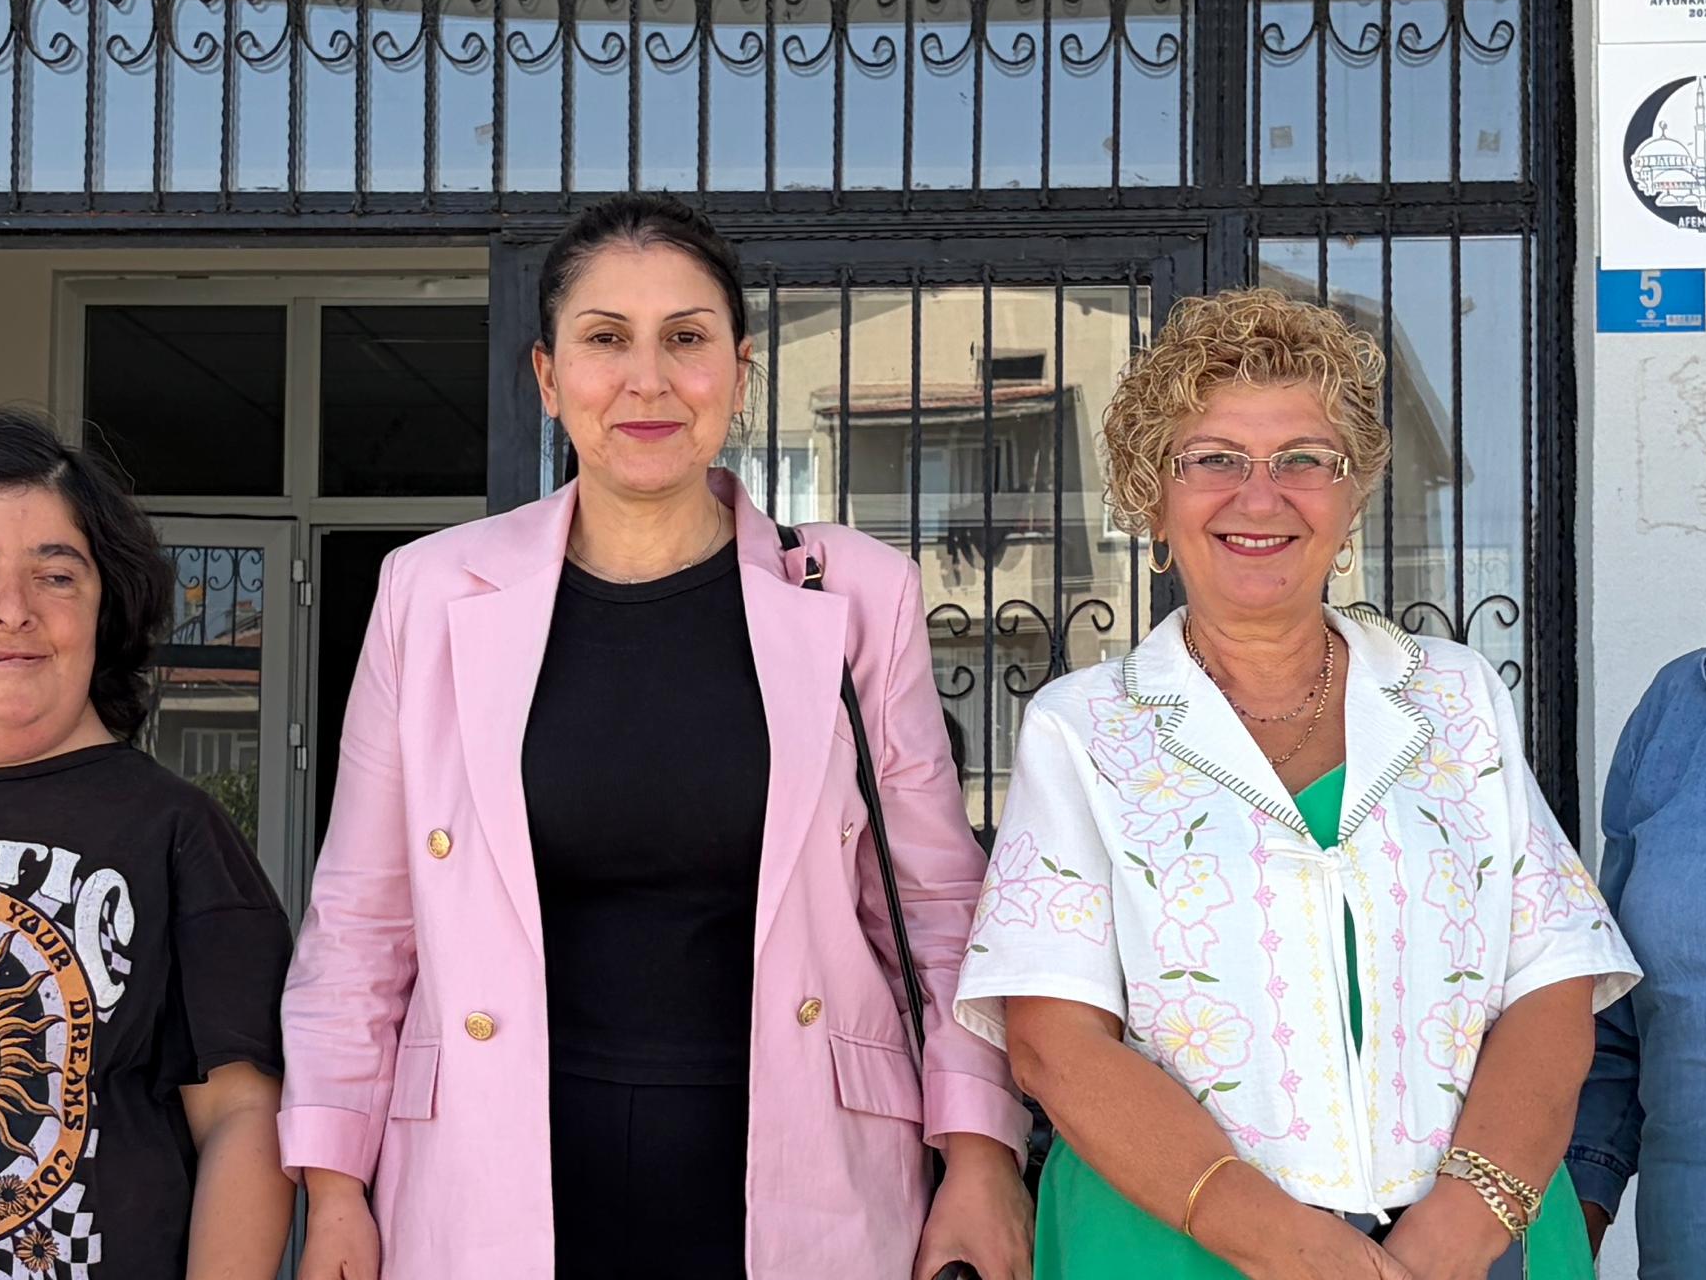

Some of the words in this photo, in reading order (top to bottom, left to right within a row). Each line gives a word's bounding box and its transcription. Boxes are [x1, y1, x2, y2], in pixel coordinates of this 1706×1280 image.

[1639, 270, 1662, 308] 5
[6, 902, 72, 972] YOUR
[63, 998, 90, 1132] DREAMS
[19, 1149, 73, 1217] COM
